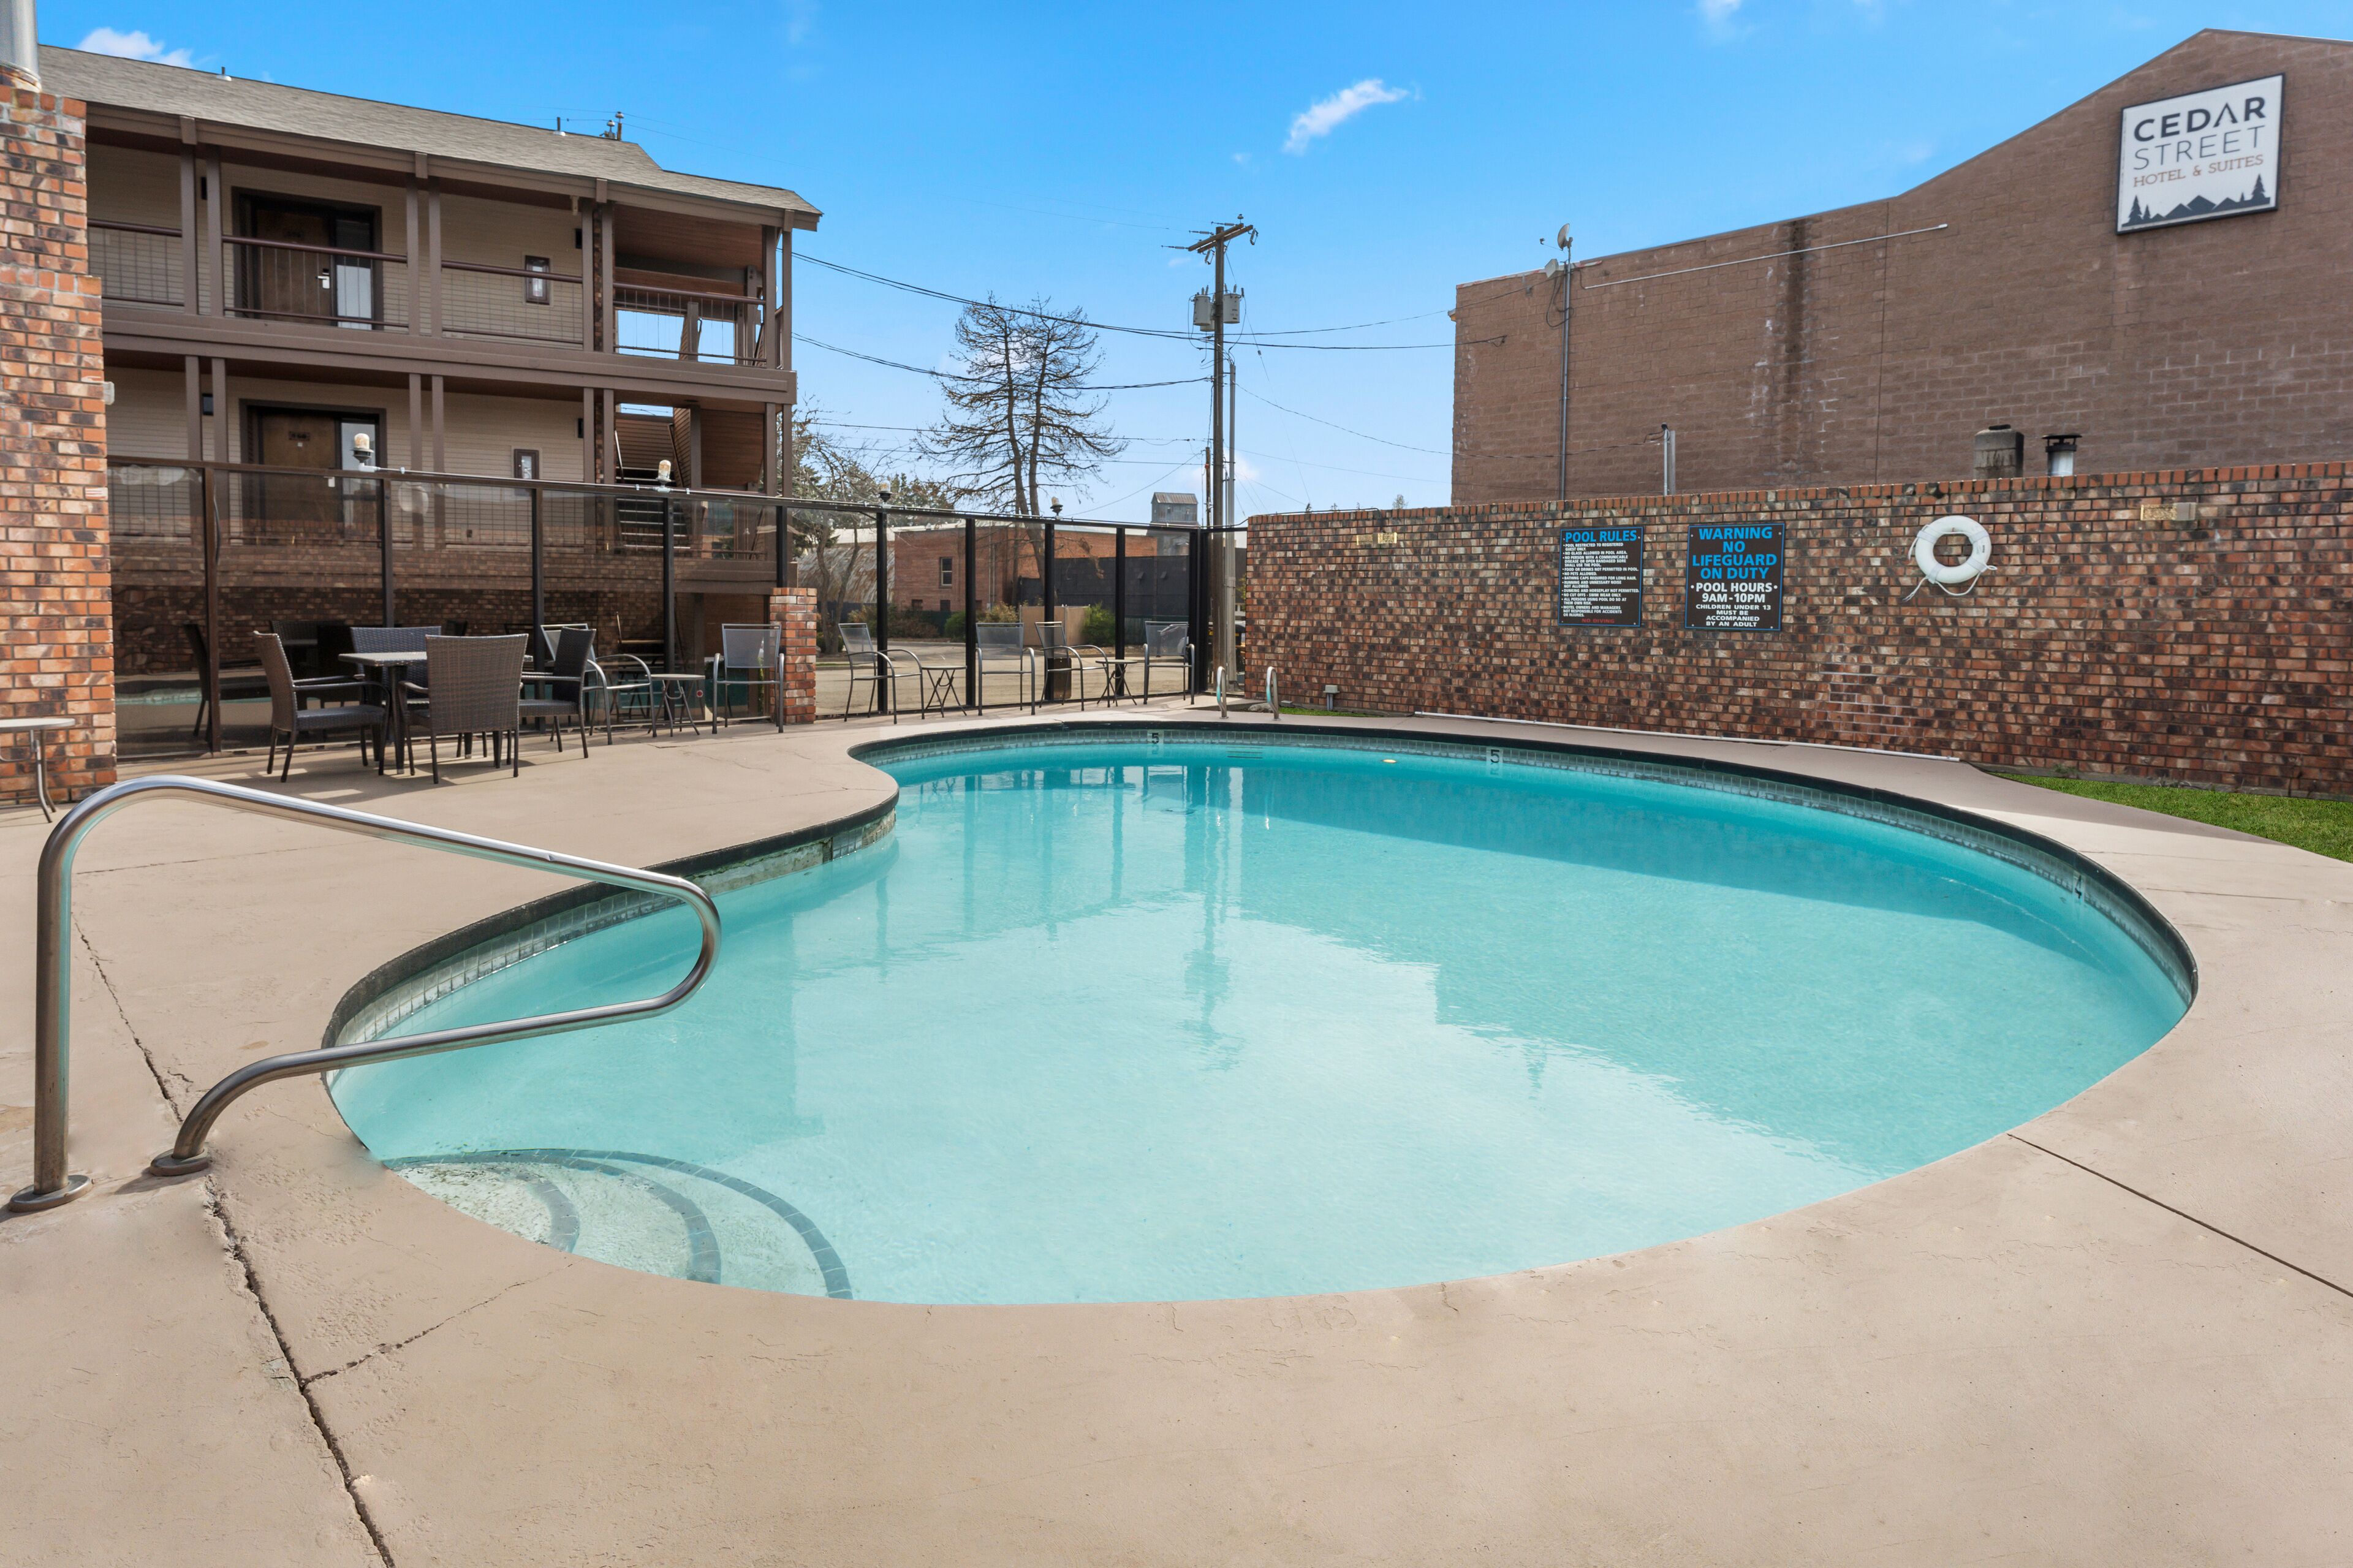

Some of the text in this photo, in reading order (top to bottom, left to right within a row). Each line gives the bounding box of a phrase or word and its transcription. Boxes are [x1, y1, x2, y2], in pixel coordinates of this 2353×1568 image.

[2134, 96, 2266, 142] CEDAR
[2133, 124, 2265, 170] STREET
[2133, 154, 2264, 187] HOTEL & SUITES
[1565, 530, 1637, 542] POOL RULES
[1699, 527, 1773, 540] WARNING
[1722, 541, 1746, 553] NO
[1692, 554, 1777, 566] LIFEGUARD
[1700, 567, 1770, 579] ON DUTY
[1696, 583, 1773, 592] POOL HOURS
[1152, 733, 1159, 744] 5
[1490, 749, 1500, 763] 5
[2075, 875, 2082, 899] 4
